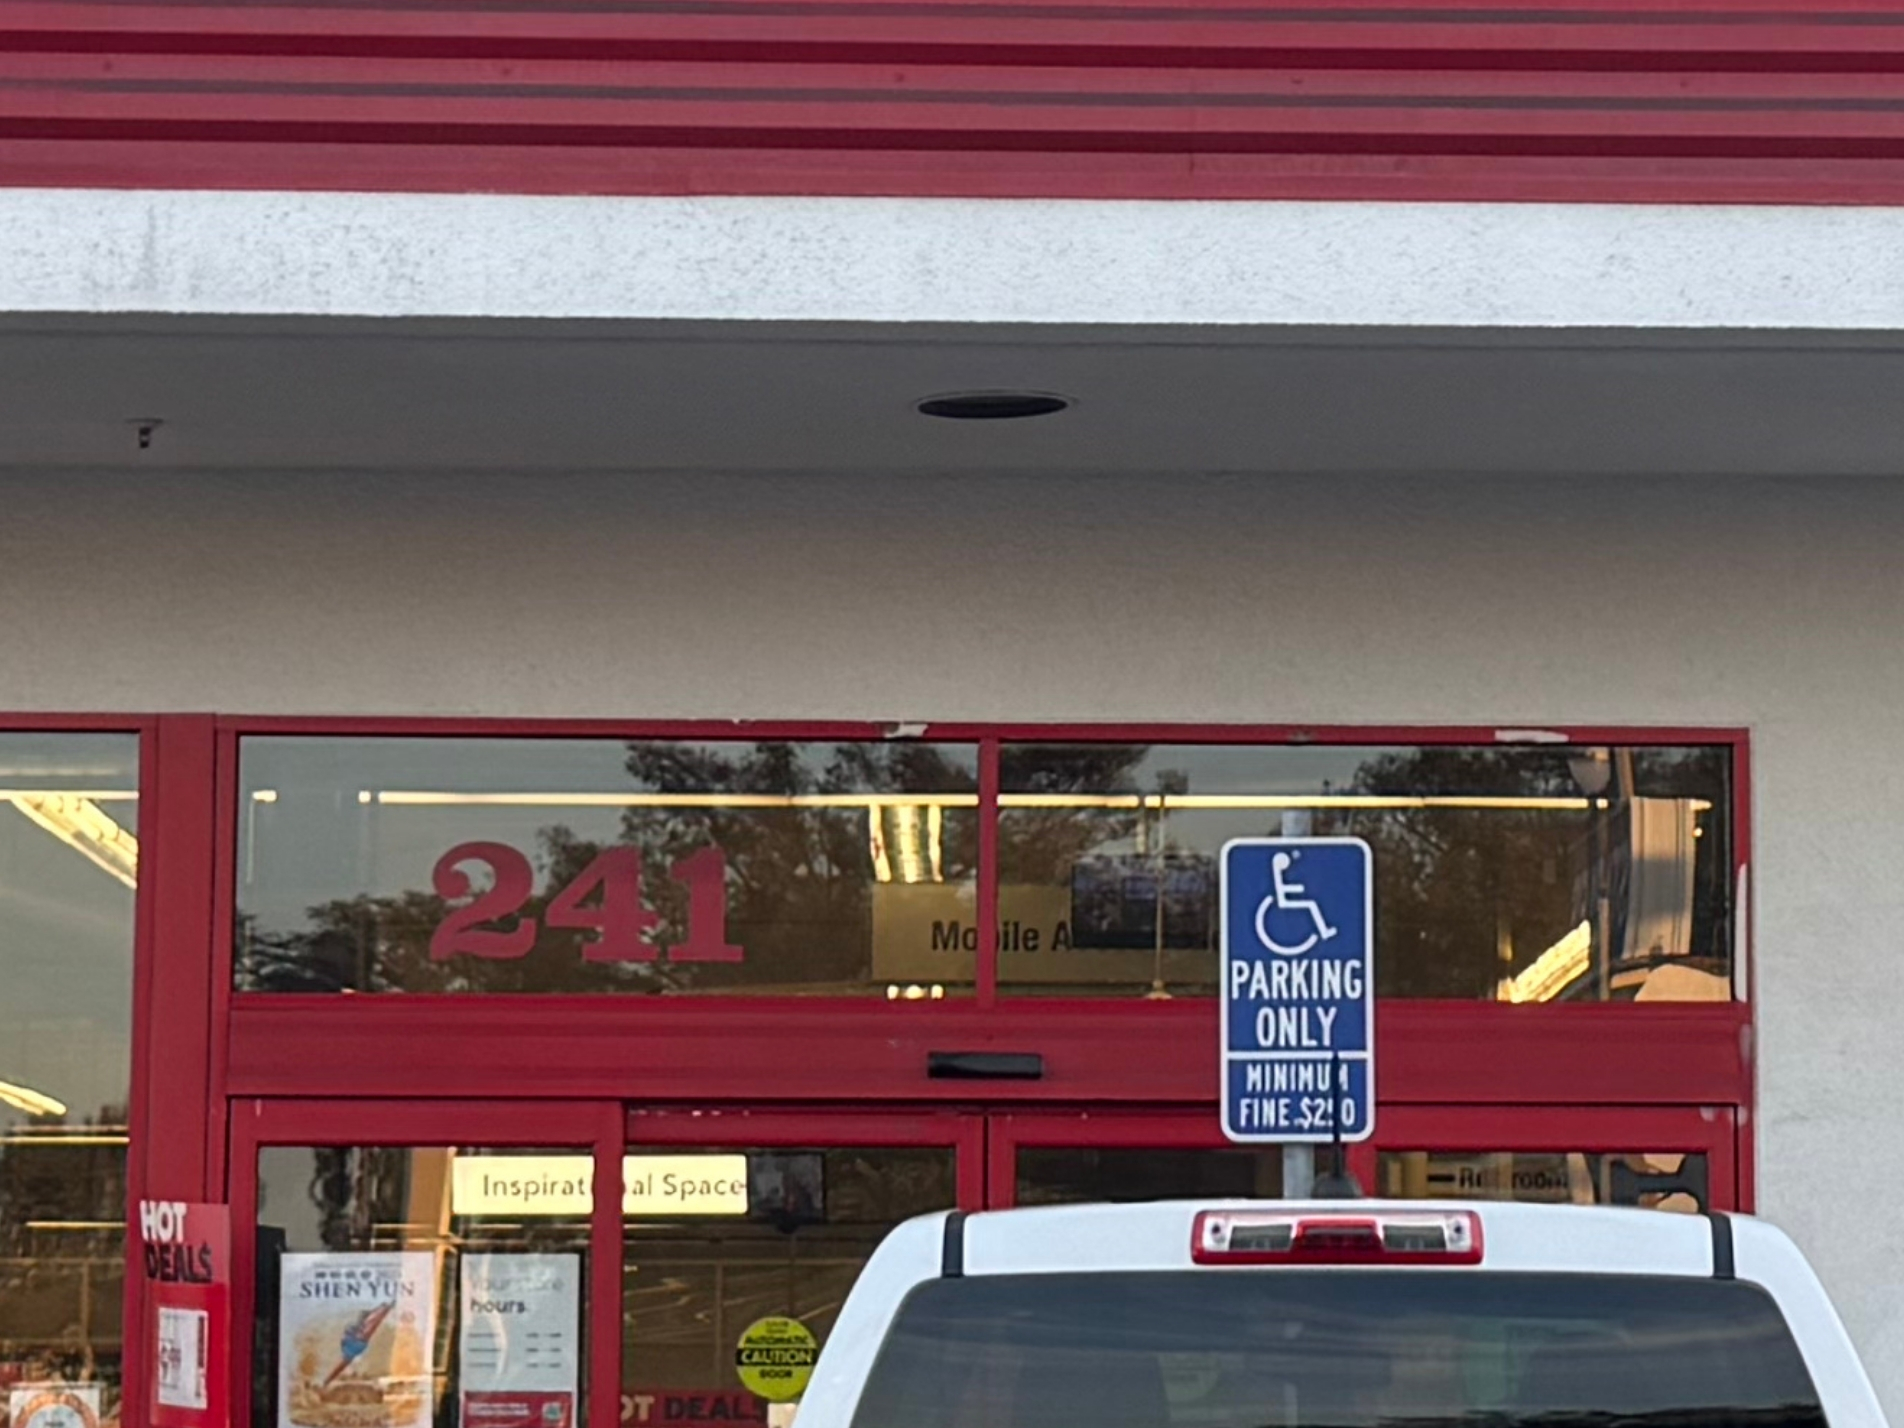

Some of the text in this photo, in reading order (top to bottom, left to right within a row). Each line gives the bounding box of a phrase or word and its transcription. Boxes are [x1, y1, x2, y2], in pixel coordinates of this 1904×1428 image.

[430, 840, 744, 963] 241
[1231, 958, 1363, 1001] PARKING
[1256, 1006, 1337, 1047] ONLY
[1240, 1097, 1292, 1128] FINE
[139, 1199, 187, 1244] HOT
[299, 1279, 416, 1299] SHEN YUN
[740, 1349, 812, 1364] CAUTION
